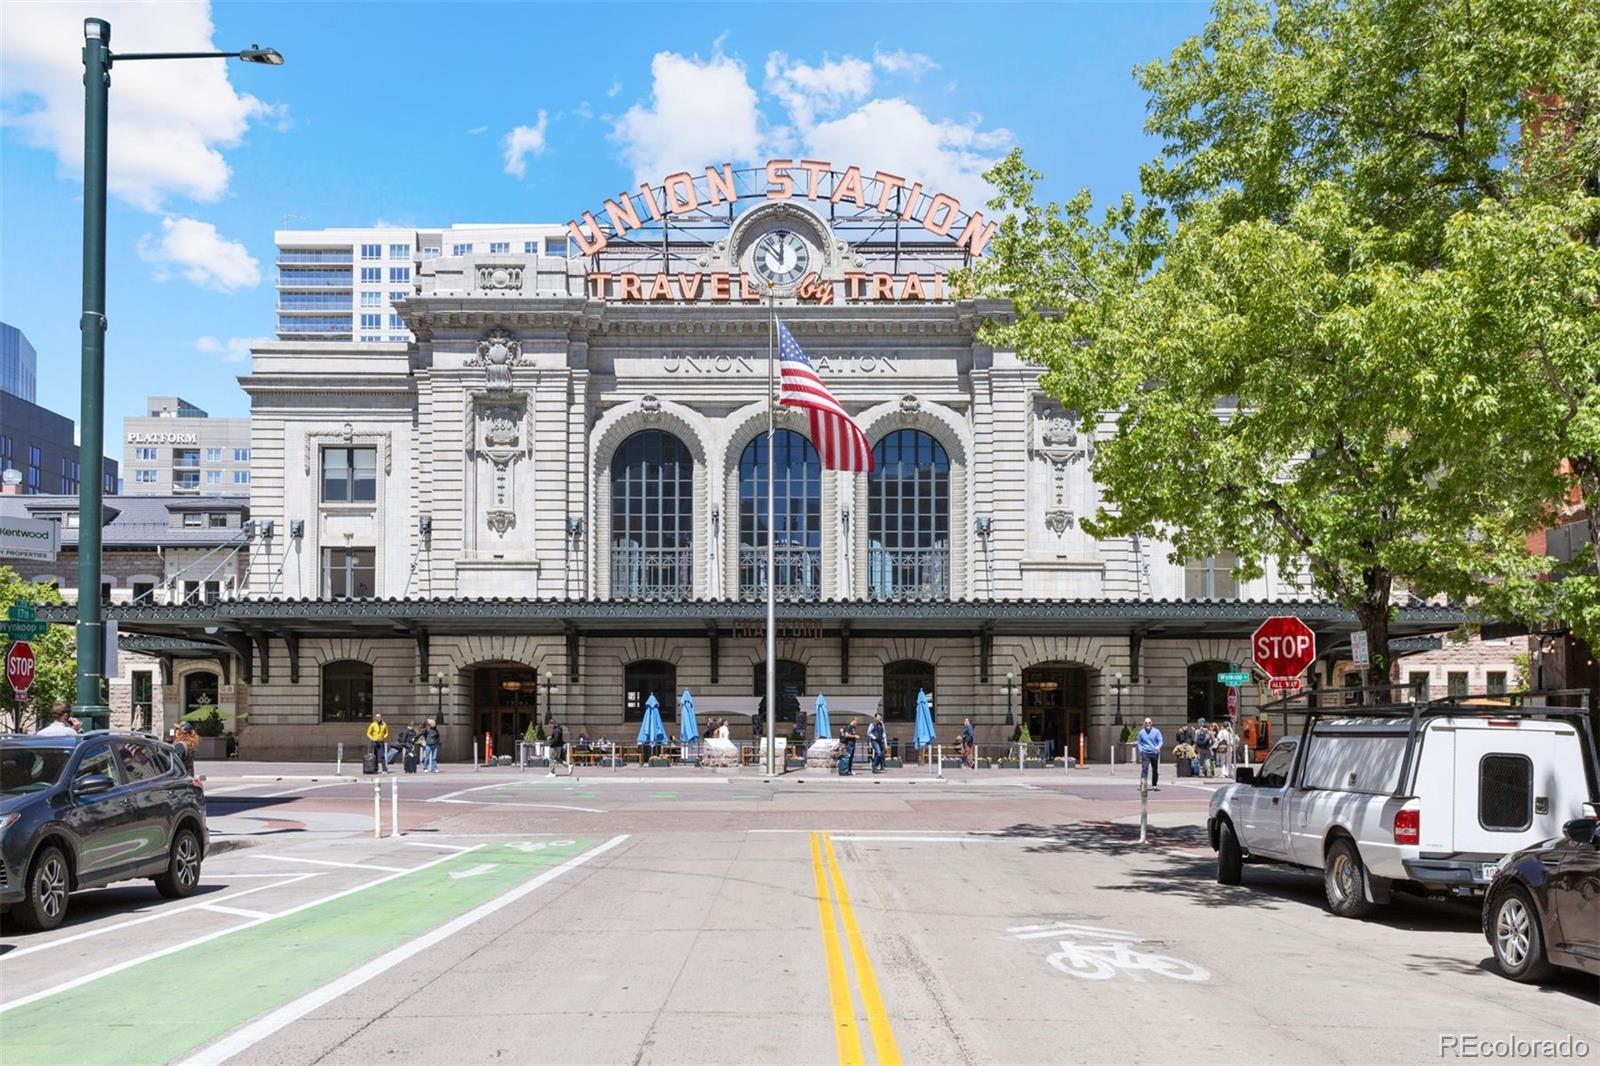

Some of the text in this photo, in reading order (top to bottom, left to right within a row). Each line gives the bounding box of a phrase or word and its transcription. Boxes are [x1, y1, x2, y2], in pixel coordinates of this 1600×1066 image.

[567, 159, 998, 257] UNION STATION
[588, 271, 973, 305] TRAVEL by TRAI
[664, 355, 753, 373] UNION
[128, 432, 198, 444] PLATFORM
[6, 550, 47, 558] PROPERTIES
[0, 622, 37, 633] Wynkoop
[1257, 636, 1310, 660] STOP
[9, 657, 34, 676] STOP
